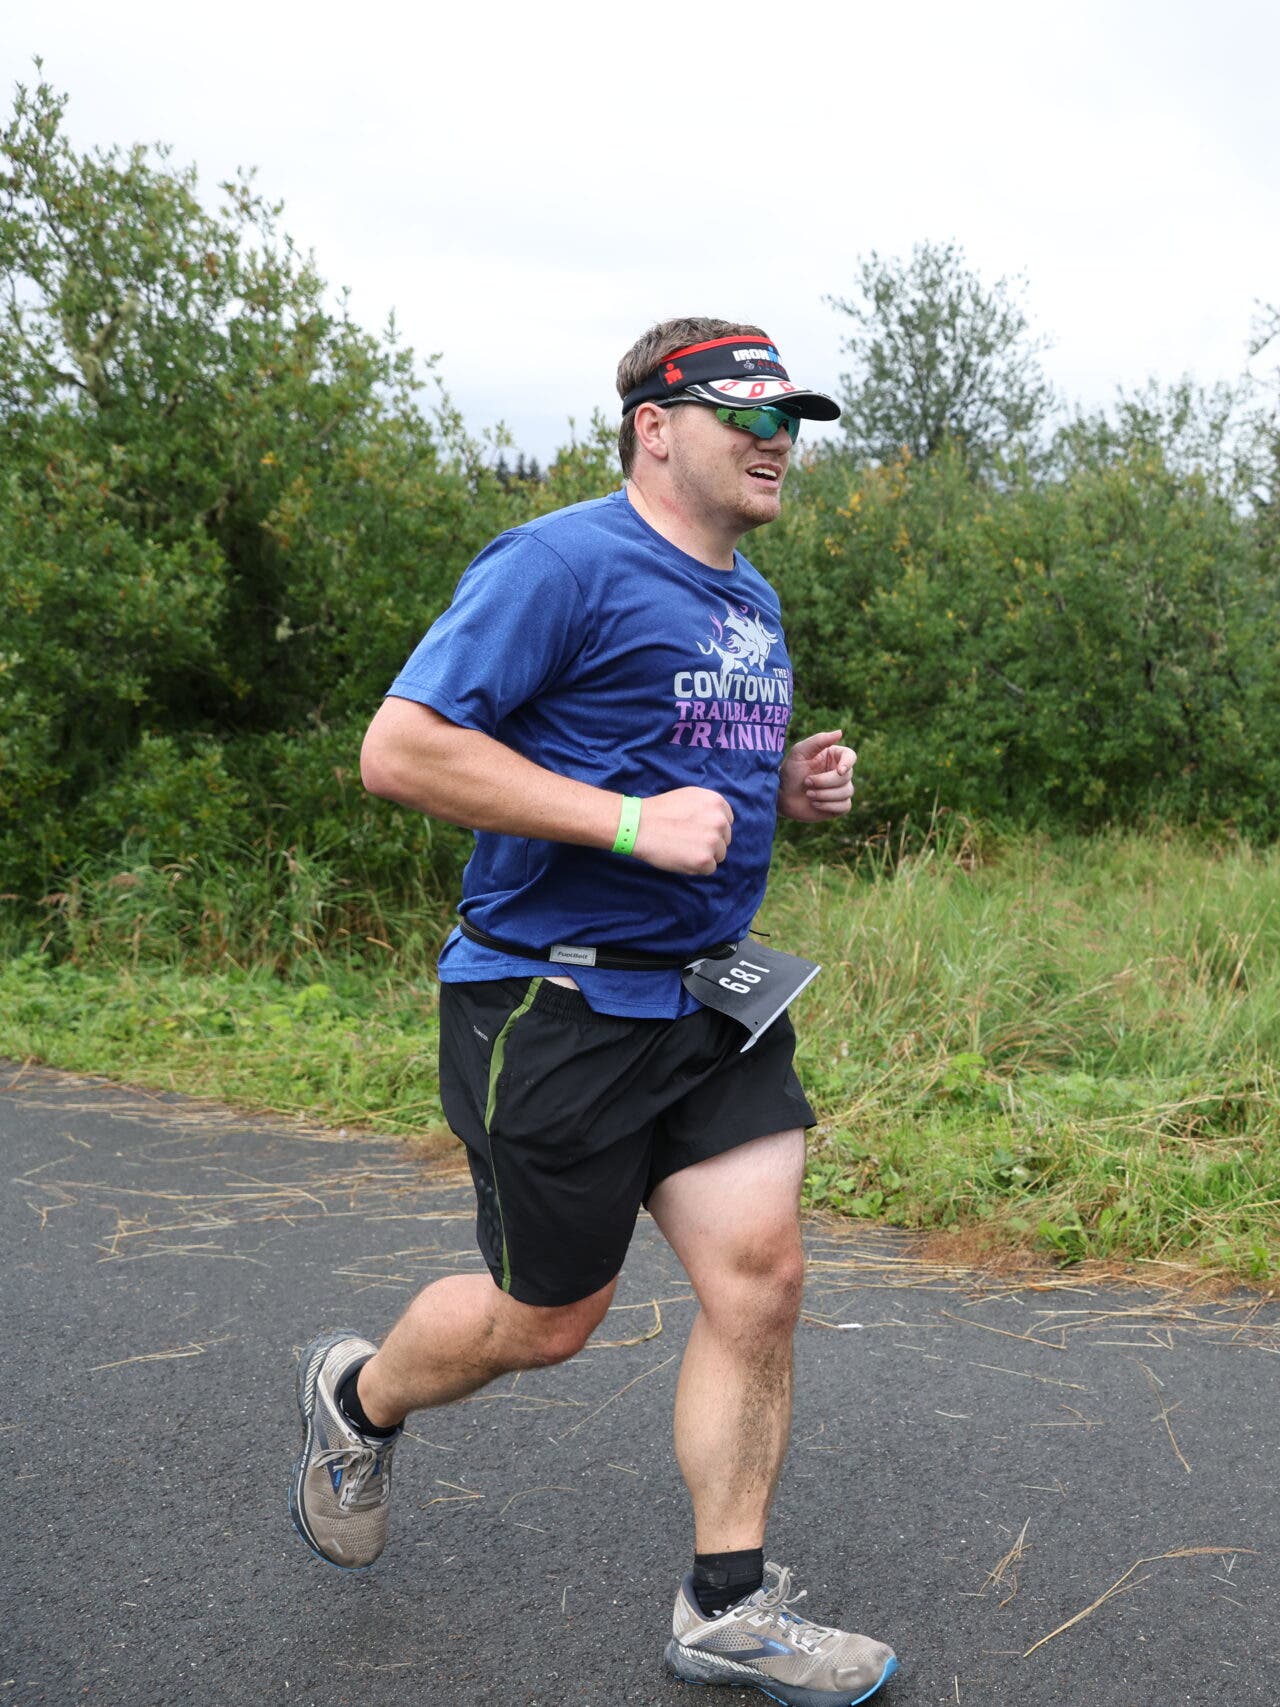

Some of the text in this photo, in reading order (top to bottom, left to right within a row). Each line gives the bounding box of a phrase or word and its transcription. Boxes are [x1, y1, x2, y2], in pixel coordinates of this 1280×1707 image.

[674, 671, 789, 705] COWTOWN
[773, 668, 788, 679] THE
[674, 701, 789, 725] TRAILBLAZER
[669, 721, 786, 752] TRAINING
[718, 960, 771, 994] 681
